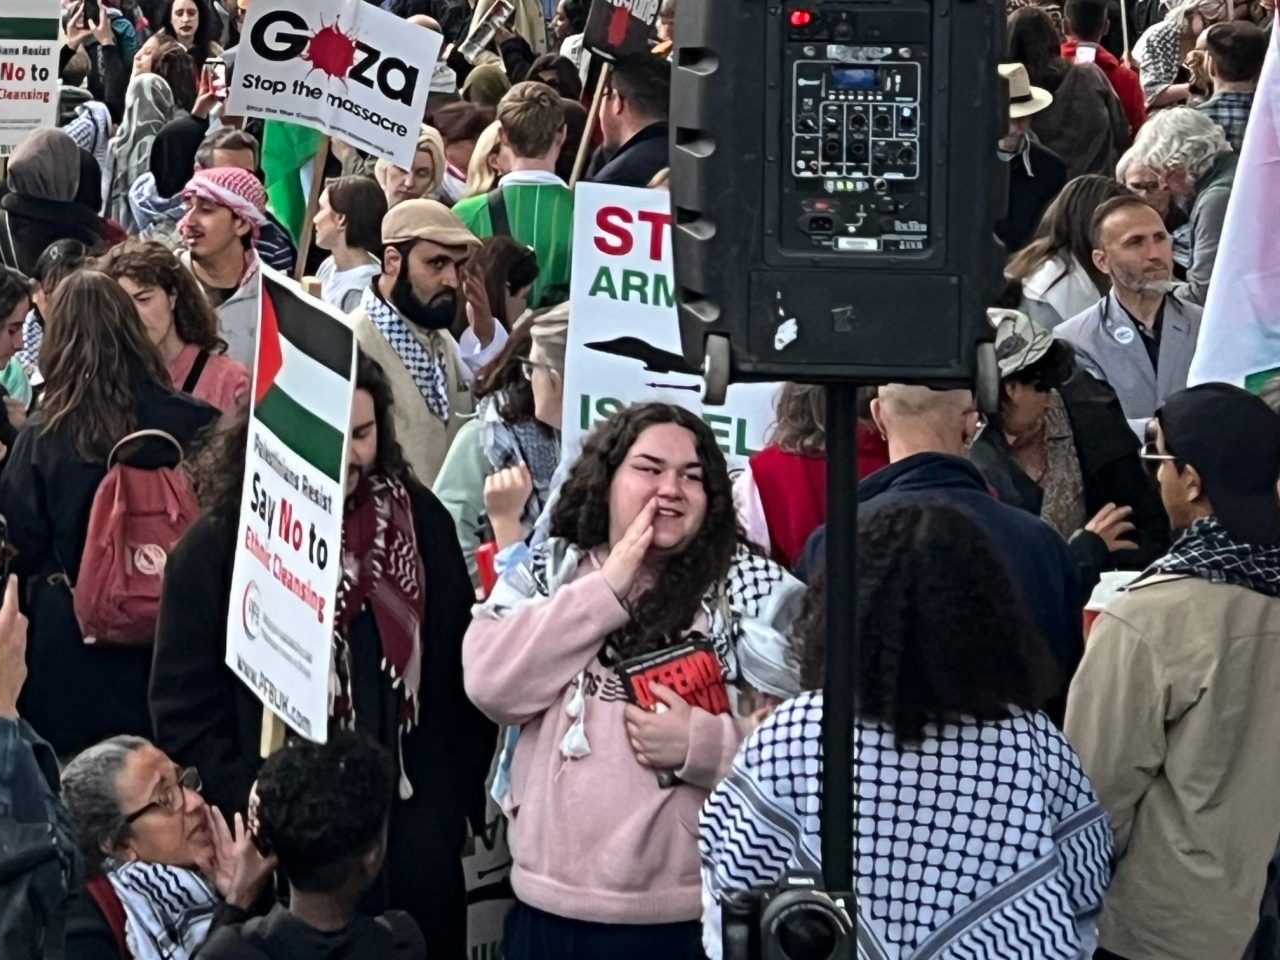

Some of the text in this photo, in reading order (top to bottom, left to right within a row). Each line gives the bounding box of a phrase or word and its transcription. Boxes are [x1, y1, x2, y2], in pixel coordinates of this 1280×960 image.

[0, 62, 25, 81] No
[31, 64, 49, 81] to
[250, 10, 420, 107] Gza
[242, 74, 408, 137] Stop the massacre
[593, 206, 672, 262] ST
[588, 265, 678, 309] ARM
[580, 394, 760, 456] ISEL
[251, 472, 328, 570] Say No to
[302, 474, 333, 514] Resist
[245, 524, 326, 623] Ethnic Cleansing
